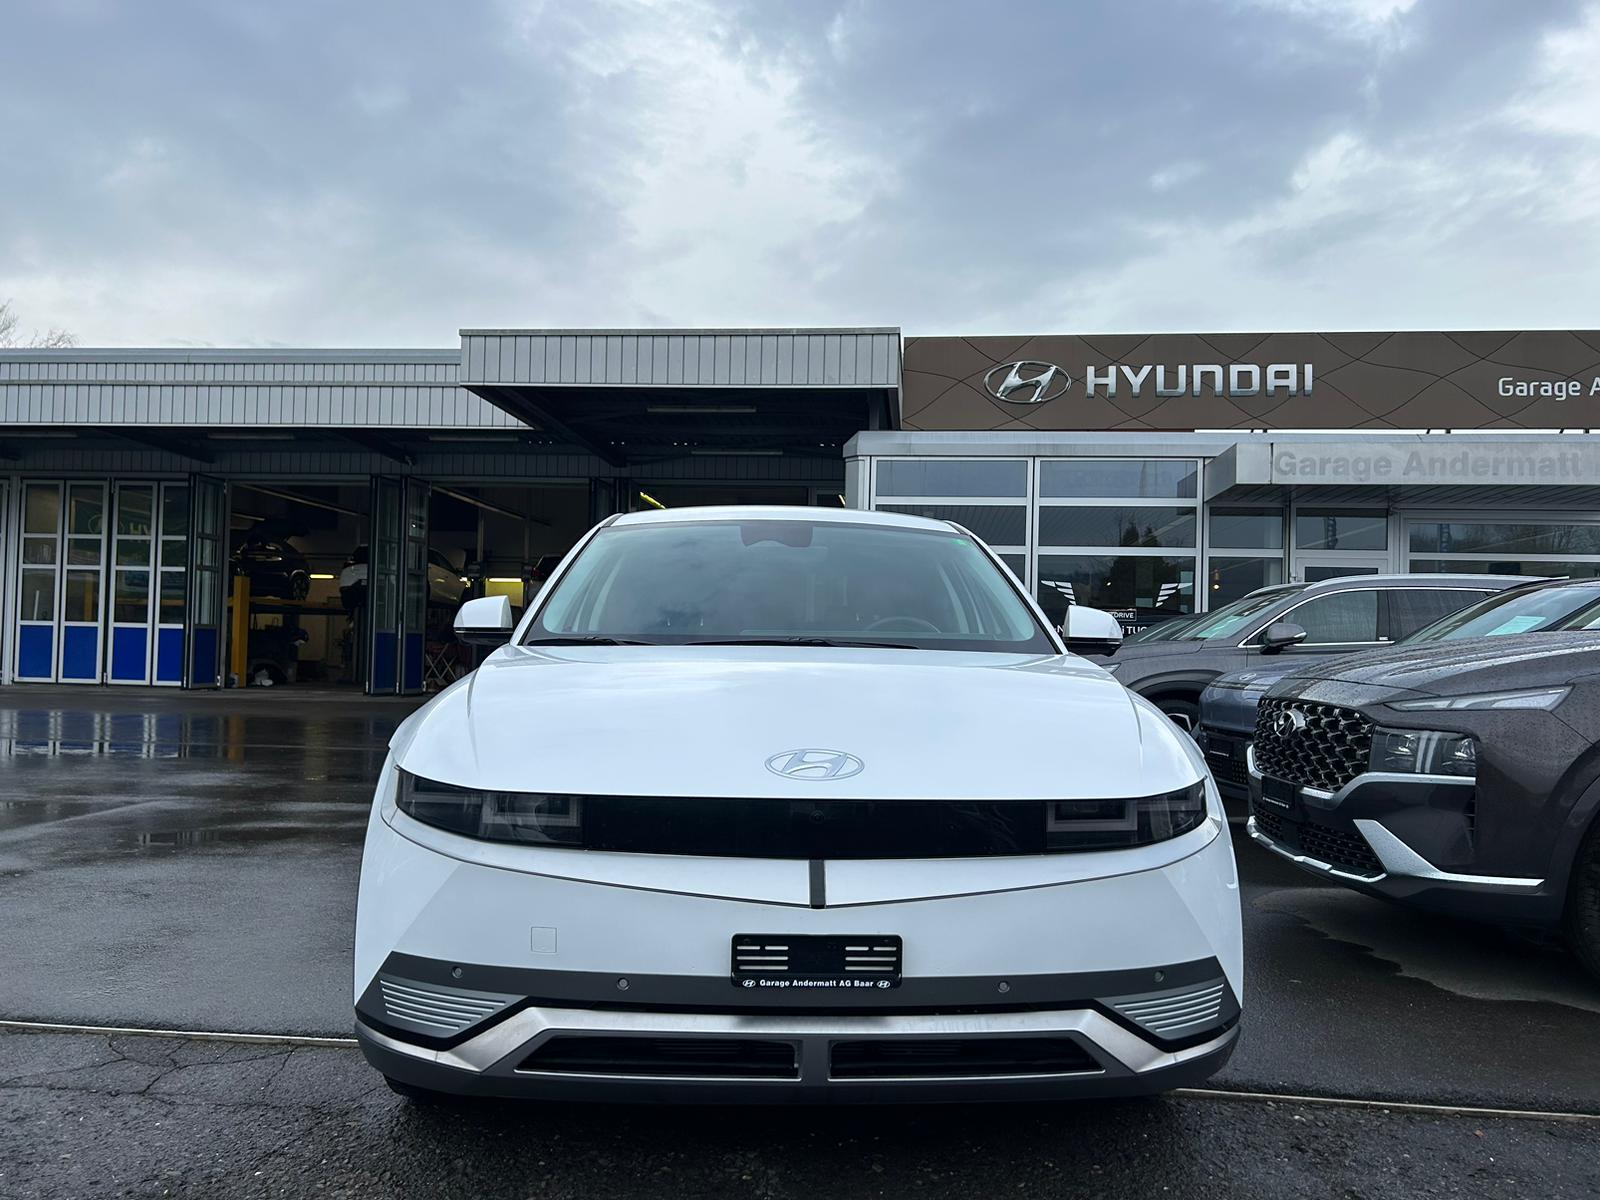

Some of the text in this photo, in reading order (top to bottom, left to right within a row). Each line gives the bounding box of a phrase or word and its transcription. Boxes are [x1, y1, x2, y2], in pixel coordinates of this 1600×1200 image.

[1086, 364, 1313, 398] HYUNDAI
[1498, 377, 1581, 401] Garage
[1275, 451, 1583, 481] Garage Andermatt
[759, 979, 790, 988] Garage
[792, 979, 837, 987] Andermatt
[839, 979, 852, 987] AG
